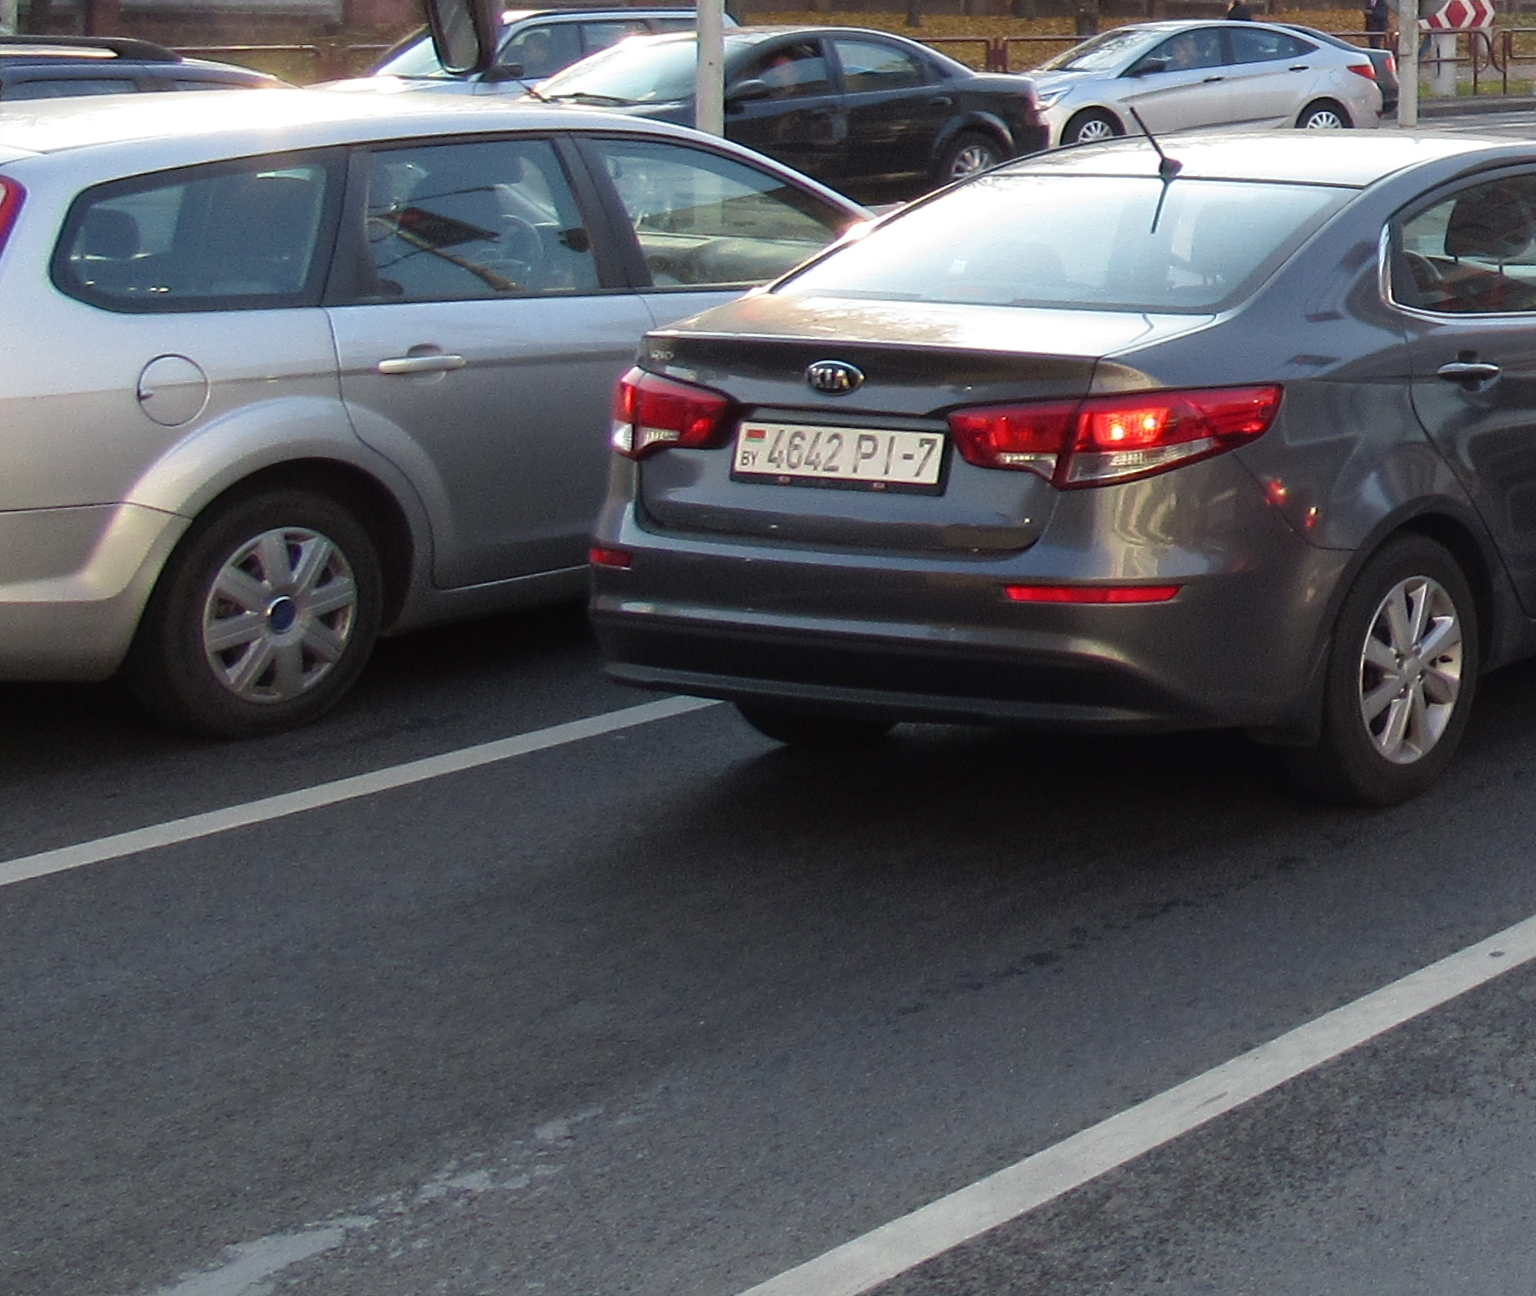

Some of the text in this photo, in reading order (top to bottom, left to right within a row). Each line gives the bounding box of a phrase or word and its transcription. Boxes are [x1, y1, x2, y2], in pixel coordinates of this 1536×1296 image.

[810, 366, 851, 390] KIA
[740, 450, 760, 467] BY
[767, 429, 845, 472] 4642
